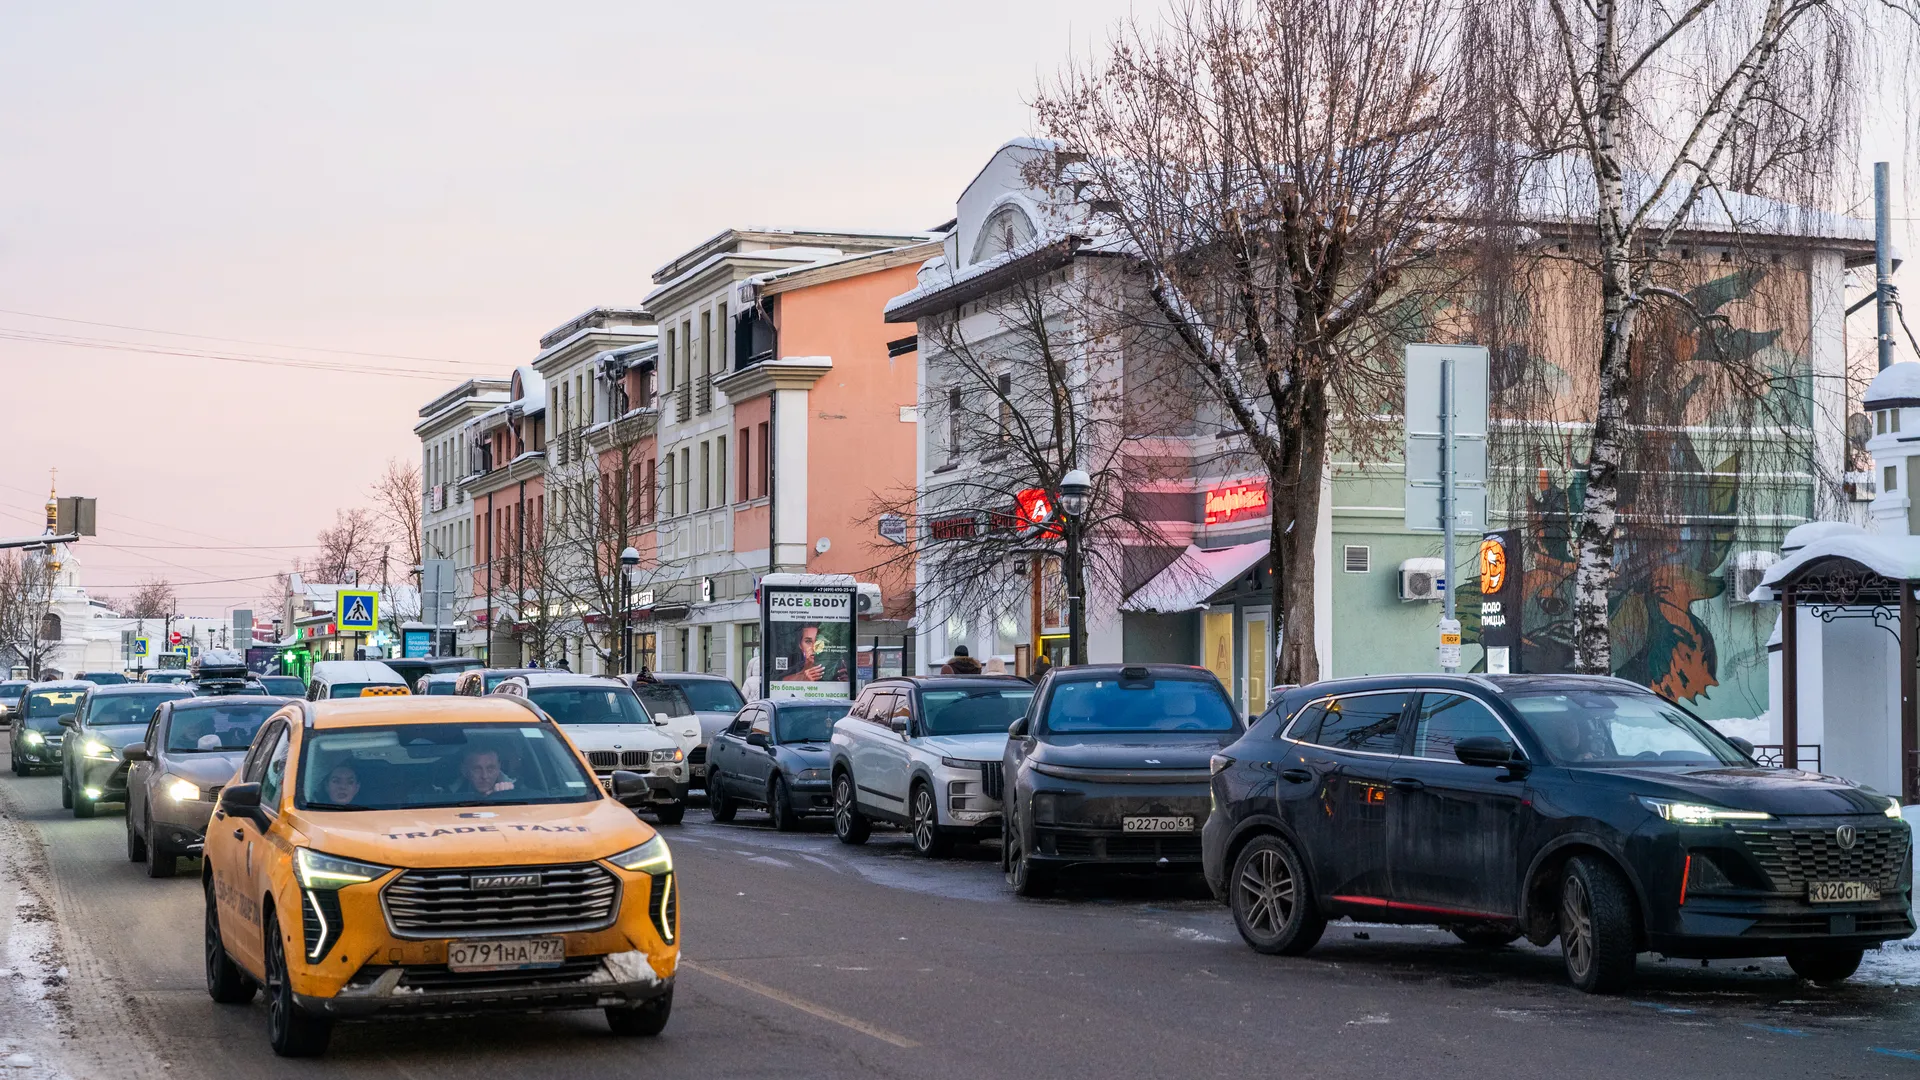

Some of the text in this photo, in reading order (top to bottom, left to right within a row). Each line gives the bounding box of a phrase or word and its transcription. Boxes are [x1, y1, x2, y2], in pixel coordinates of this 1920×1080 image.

[772, 598, 847, 608] FACE&BODY
[1481, 602, 1501, 614] ДОДО
[1481, 615, 1506, 627] ПИЦЦА
[382, 825, 499, 840] TRADE
[476, 876, 537, 888] HAVAL
[531, 940, 559, 954] 797
